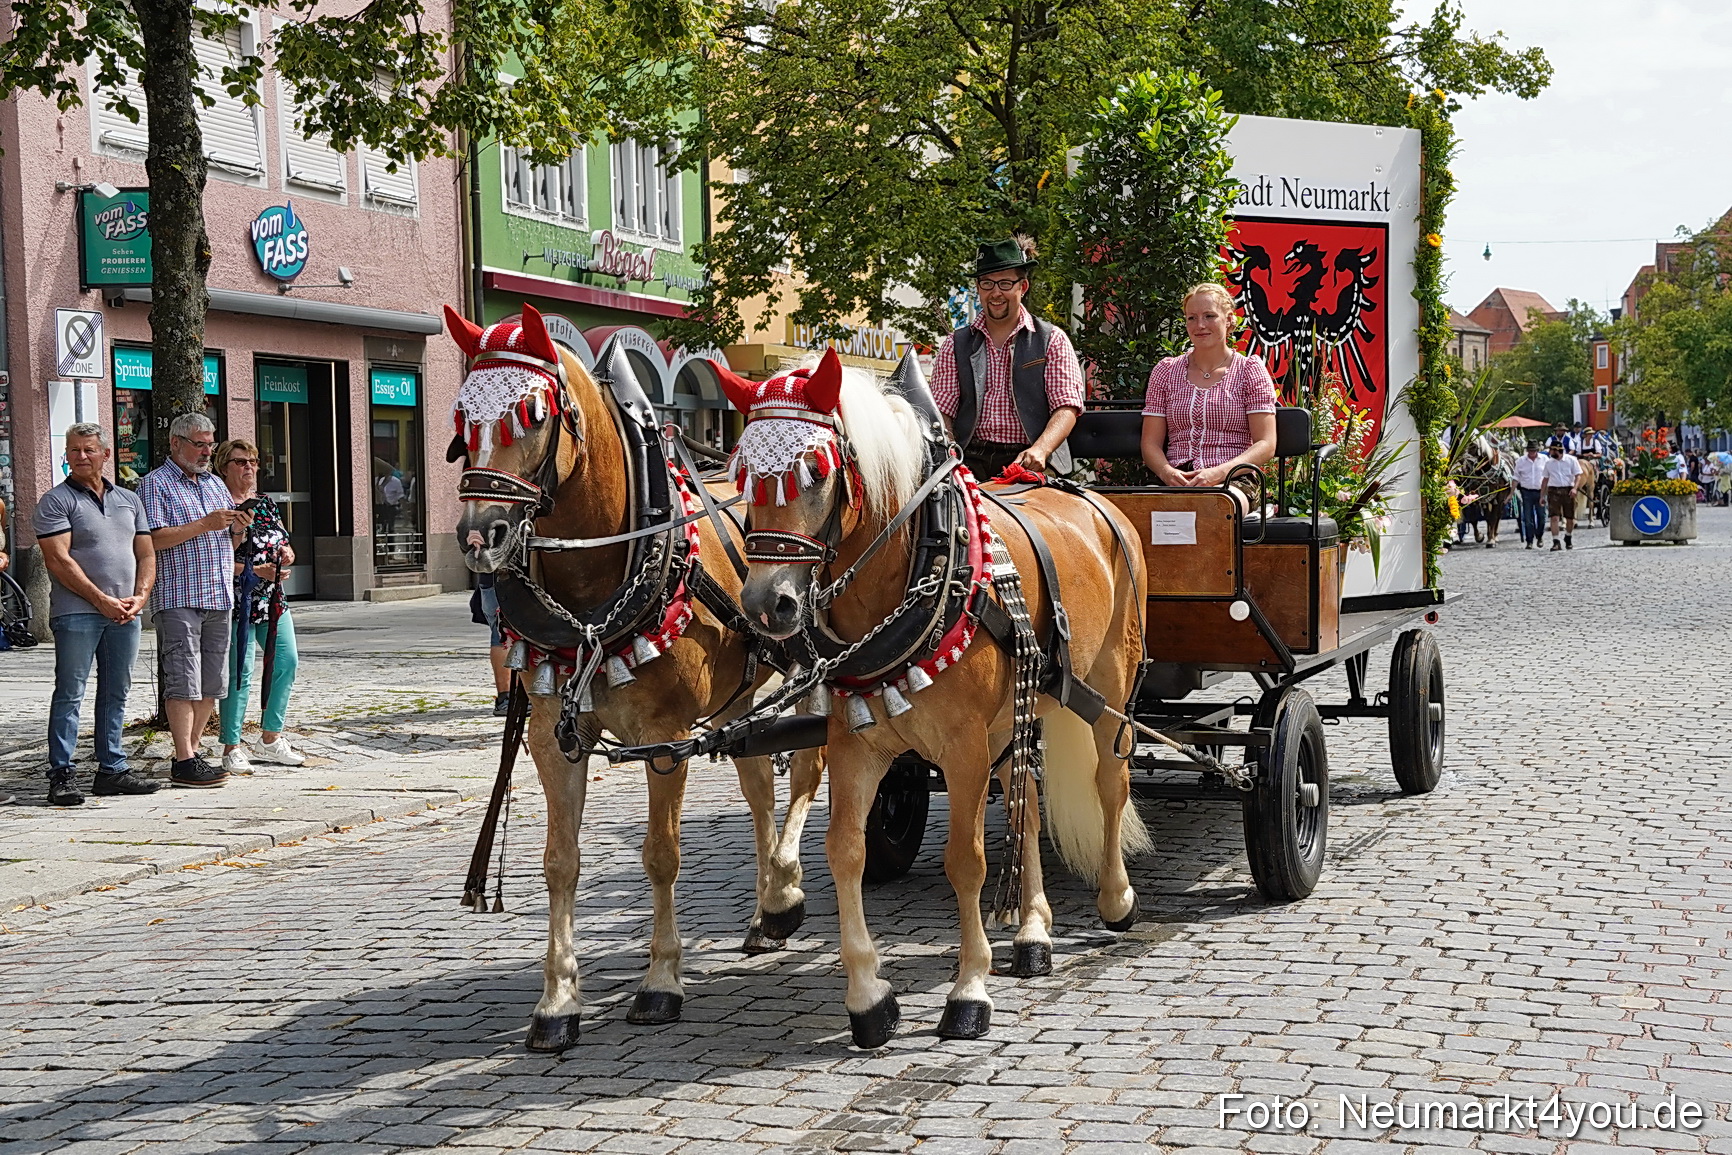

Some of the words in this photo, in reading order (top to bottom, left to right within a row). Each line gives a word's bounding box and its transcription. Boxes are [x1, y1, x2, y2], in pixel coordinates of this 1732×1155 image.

[1279, 176, 1391, 213] Neumarkt
[94, 206, 123, 226] vom
[105, 211, 148, 240] FASS
[251, 213, 283, 241] vom
[101, 257, 146, 265] PROBIEREN
[263, 230, 308, 271] FASS
[597, 229, 657, 284] Bögerl
[100, 266, 147, 275] GENIESSEN
[71, 363, 94, 374] ZONE
[203, 365, 218, 388] ky
[264, 376, 300, 393] Feinkost
[374, 379, 396, 399] Essig
[401, 377, 411, 396] Öl
[157, 416, 169, 429] 38
